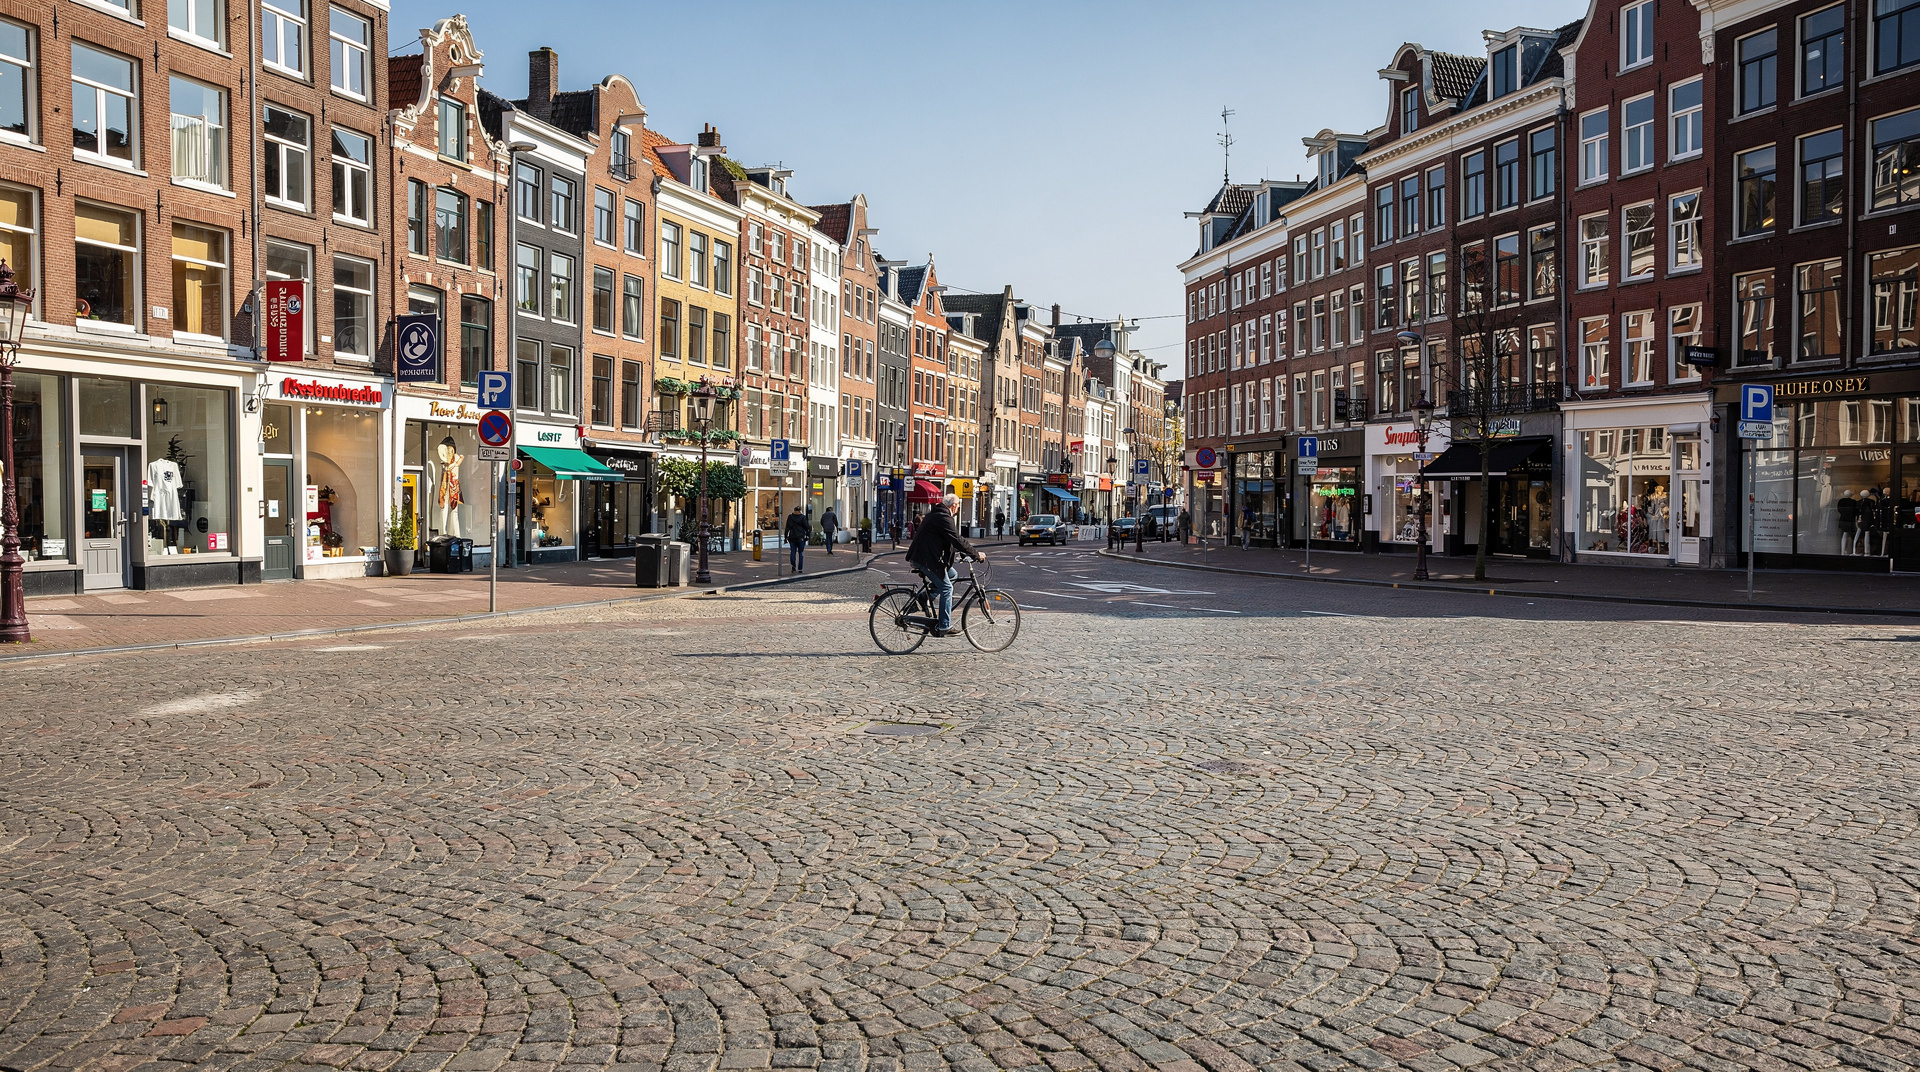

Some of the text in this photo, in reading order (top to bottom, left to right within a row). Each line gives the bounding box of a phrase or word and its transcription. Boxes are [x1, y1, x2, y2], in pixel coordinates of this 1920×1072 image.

[483, 374, 507, 405] P
[1747, 387, 1769, 418] P
[849, 462, 860, 475] P
[1137, 461, 1147, 474] P
